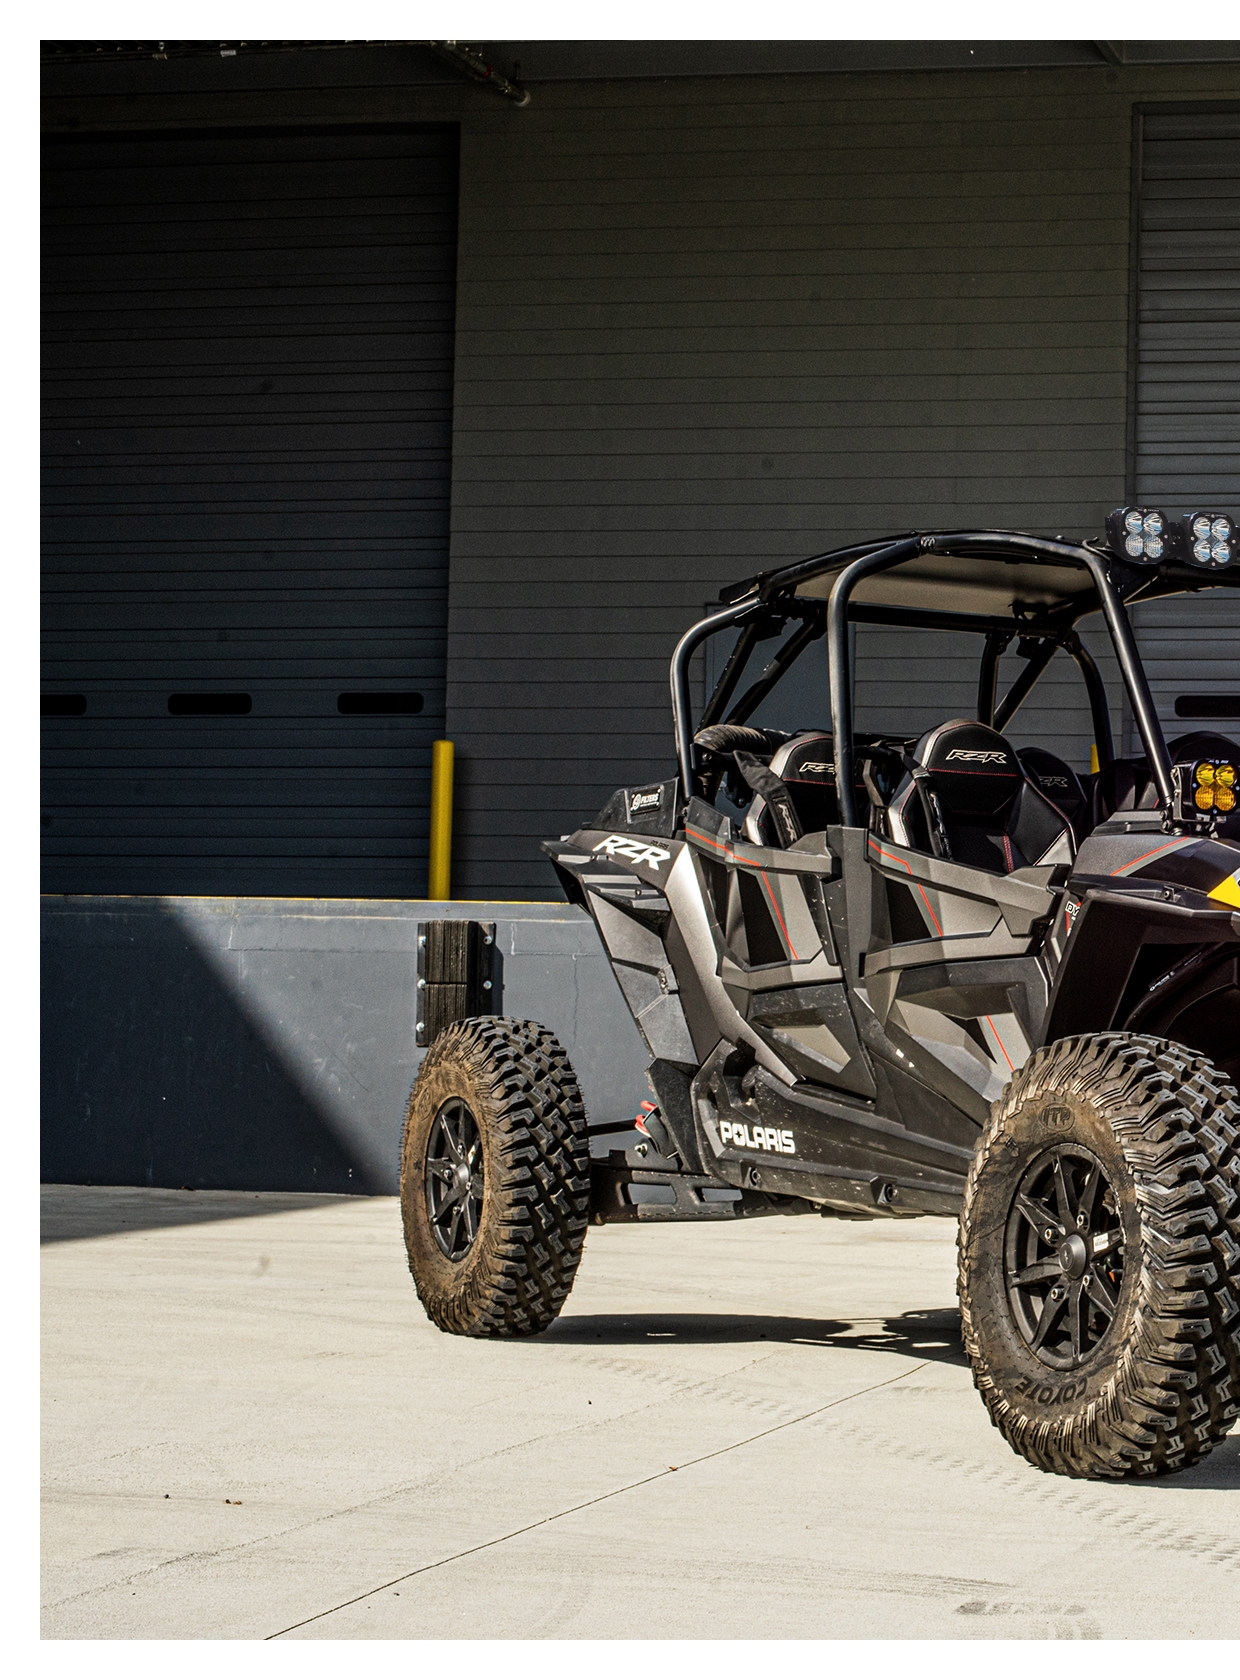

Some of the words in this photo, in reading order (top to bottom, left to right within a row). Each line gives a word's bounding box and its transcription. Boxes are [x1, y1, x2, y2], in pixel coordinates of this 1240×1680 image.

[945, 749, 1007, 764] RZR
[799, 762, 835, 775] RZ
[1038, 775, 1069, 788] ZR
[592, 834, 671, 871] RZR
[649, 839, 671, 851] POLARIS
[1042, 1107, 1071, 1126] ITP
[719, 1120, 796, 1154] POLARIS
[1013, 1375, 1088, 1406] COYOTE
